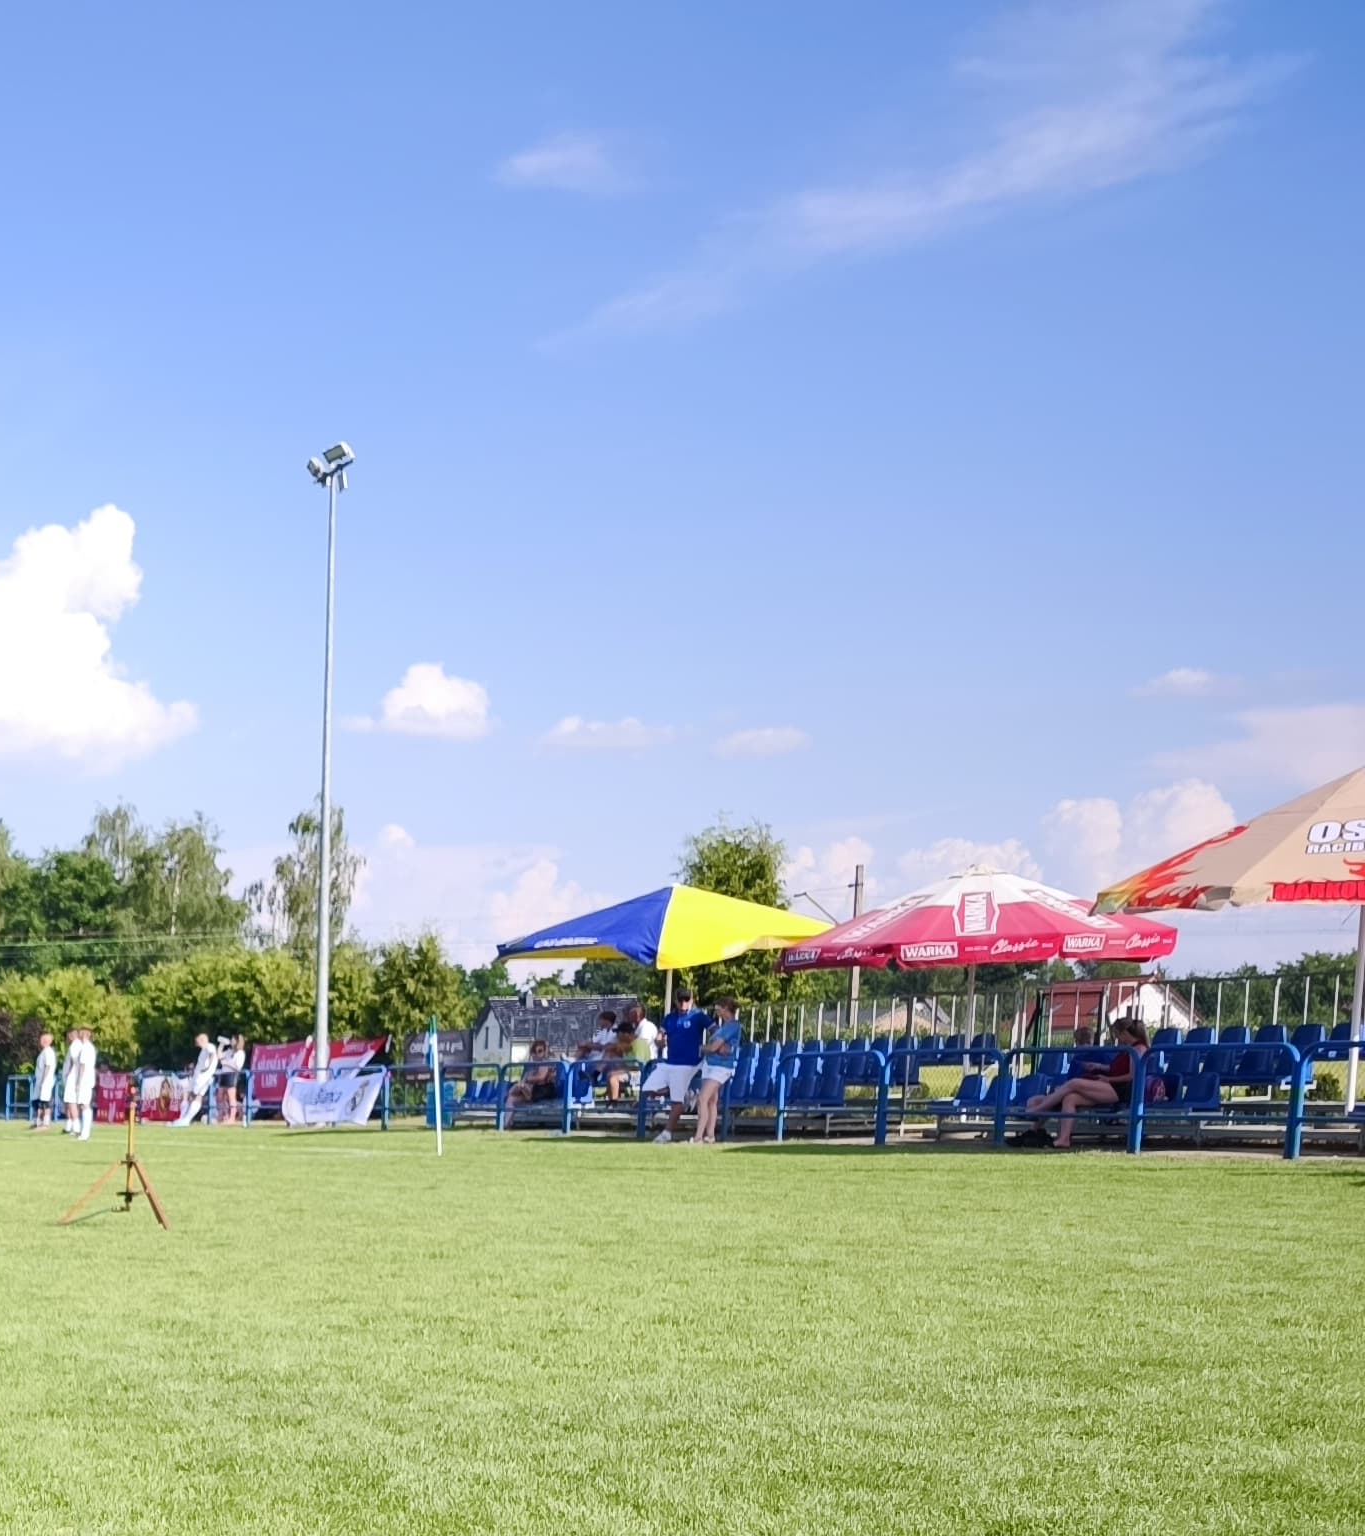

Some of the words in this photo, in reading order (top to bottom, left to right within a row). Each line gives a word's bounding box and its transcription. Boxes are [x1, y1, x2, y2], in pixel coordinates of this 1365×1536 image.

[990, 937, 1039, 955] Classic
[1067, 935, 1101, 949] WARKA
[1125, 932, 1161, 949] Classic
[904, 945, 953, 958] WARKA
